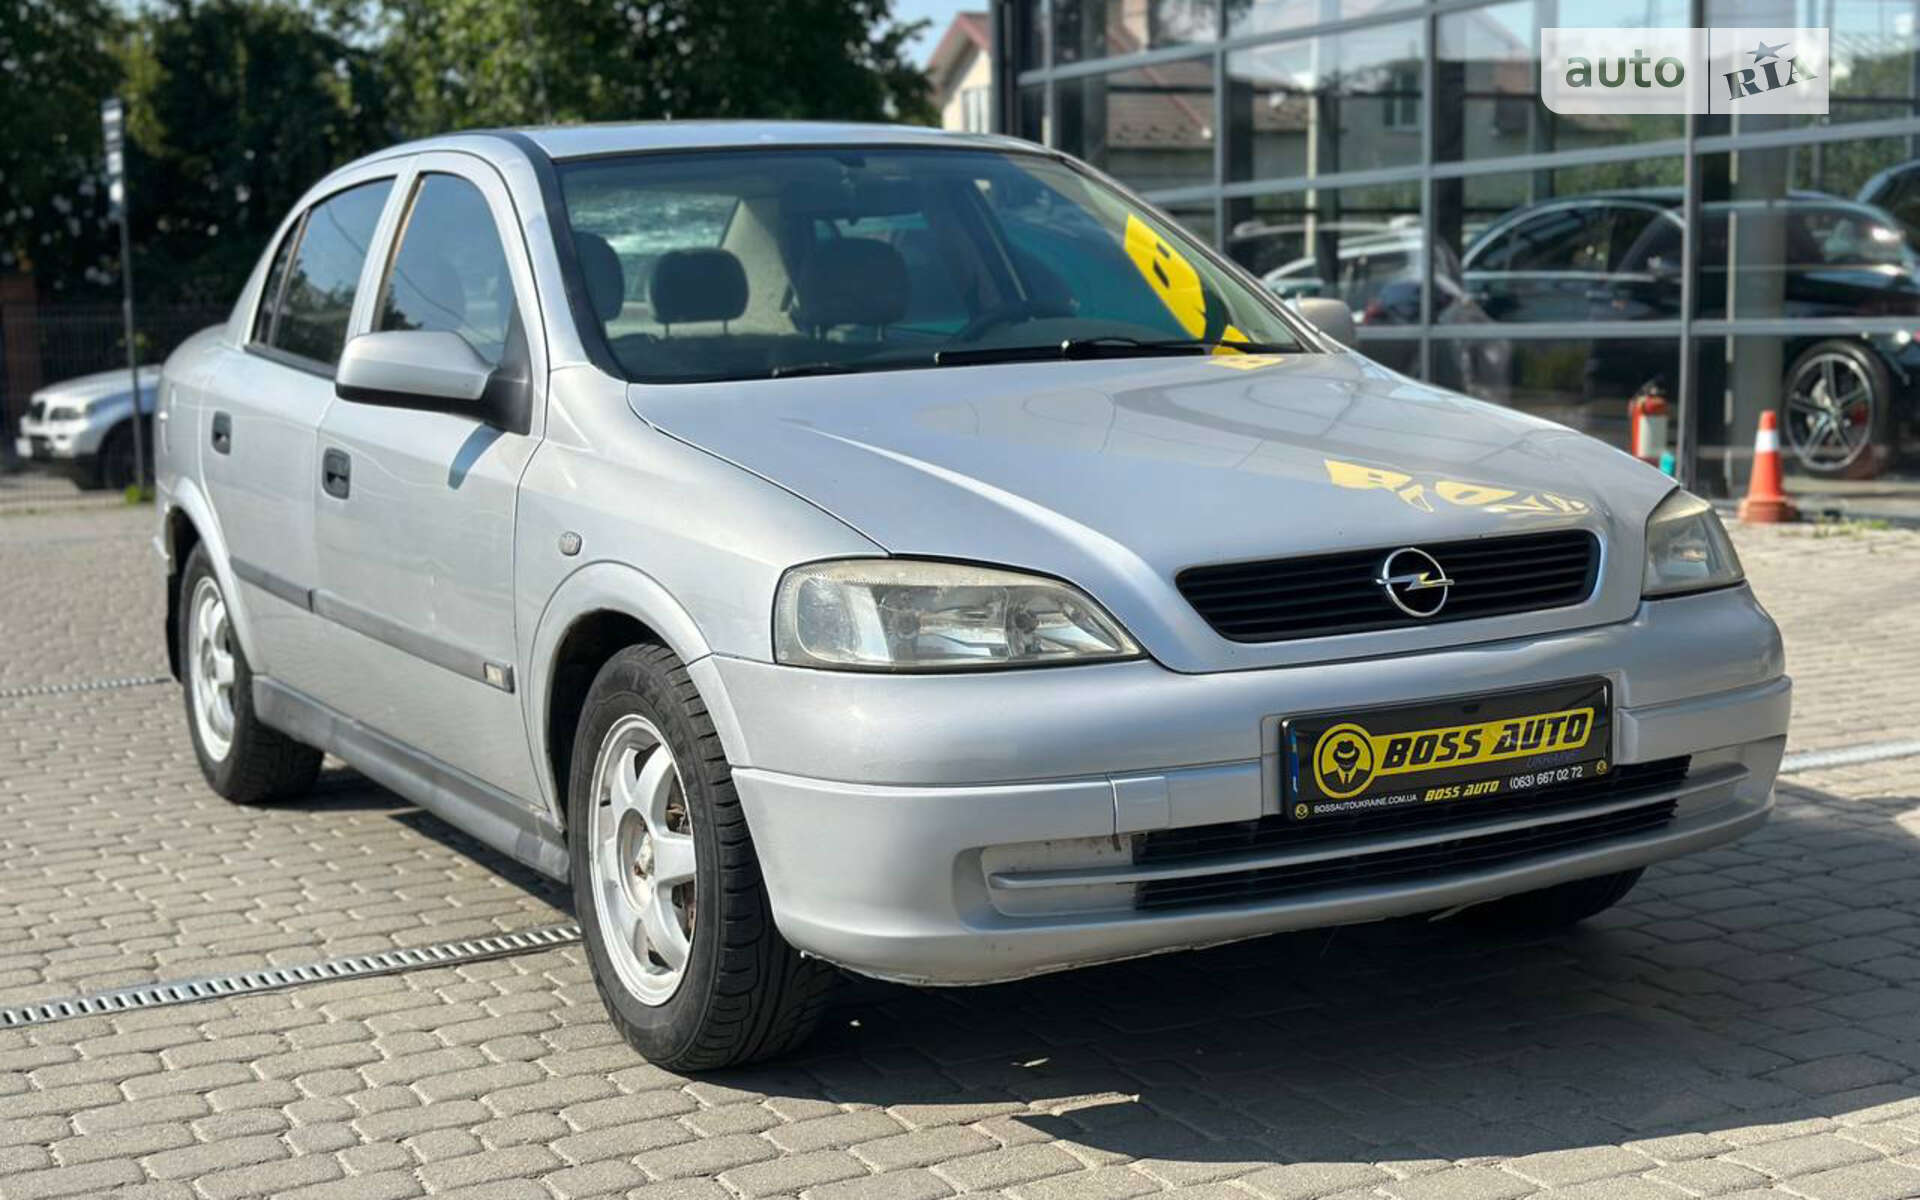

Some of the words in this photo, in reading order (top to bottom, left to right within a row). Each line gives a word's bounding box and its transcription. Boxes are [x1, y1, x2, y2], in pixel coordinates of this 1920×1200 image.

[1381, 728, 1483, 769] BOSS
[1490, 713, 1589, 755] AUTO
[1509, 777, 1534, 790] (063)
[1537, 771, 1554, 785] 667
[1556, 769, 1569, 781] 02
[1571, 766, 1584, 778] 72
[1424, 786, 1460, 802] BOSS
[1463, 780, 1500, 797] AUTO
